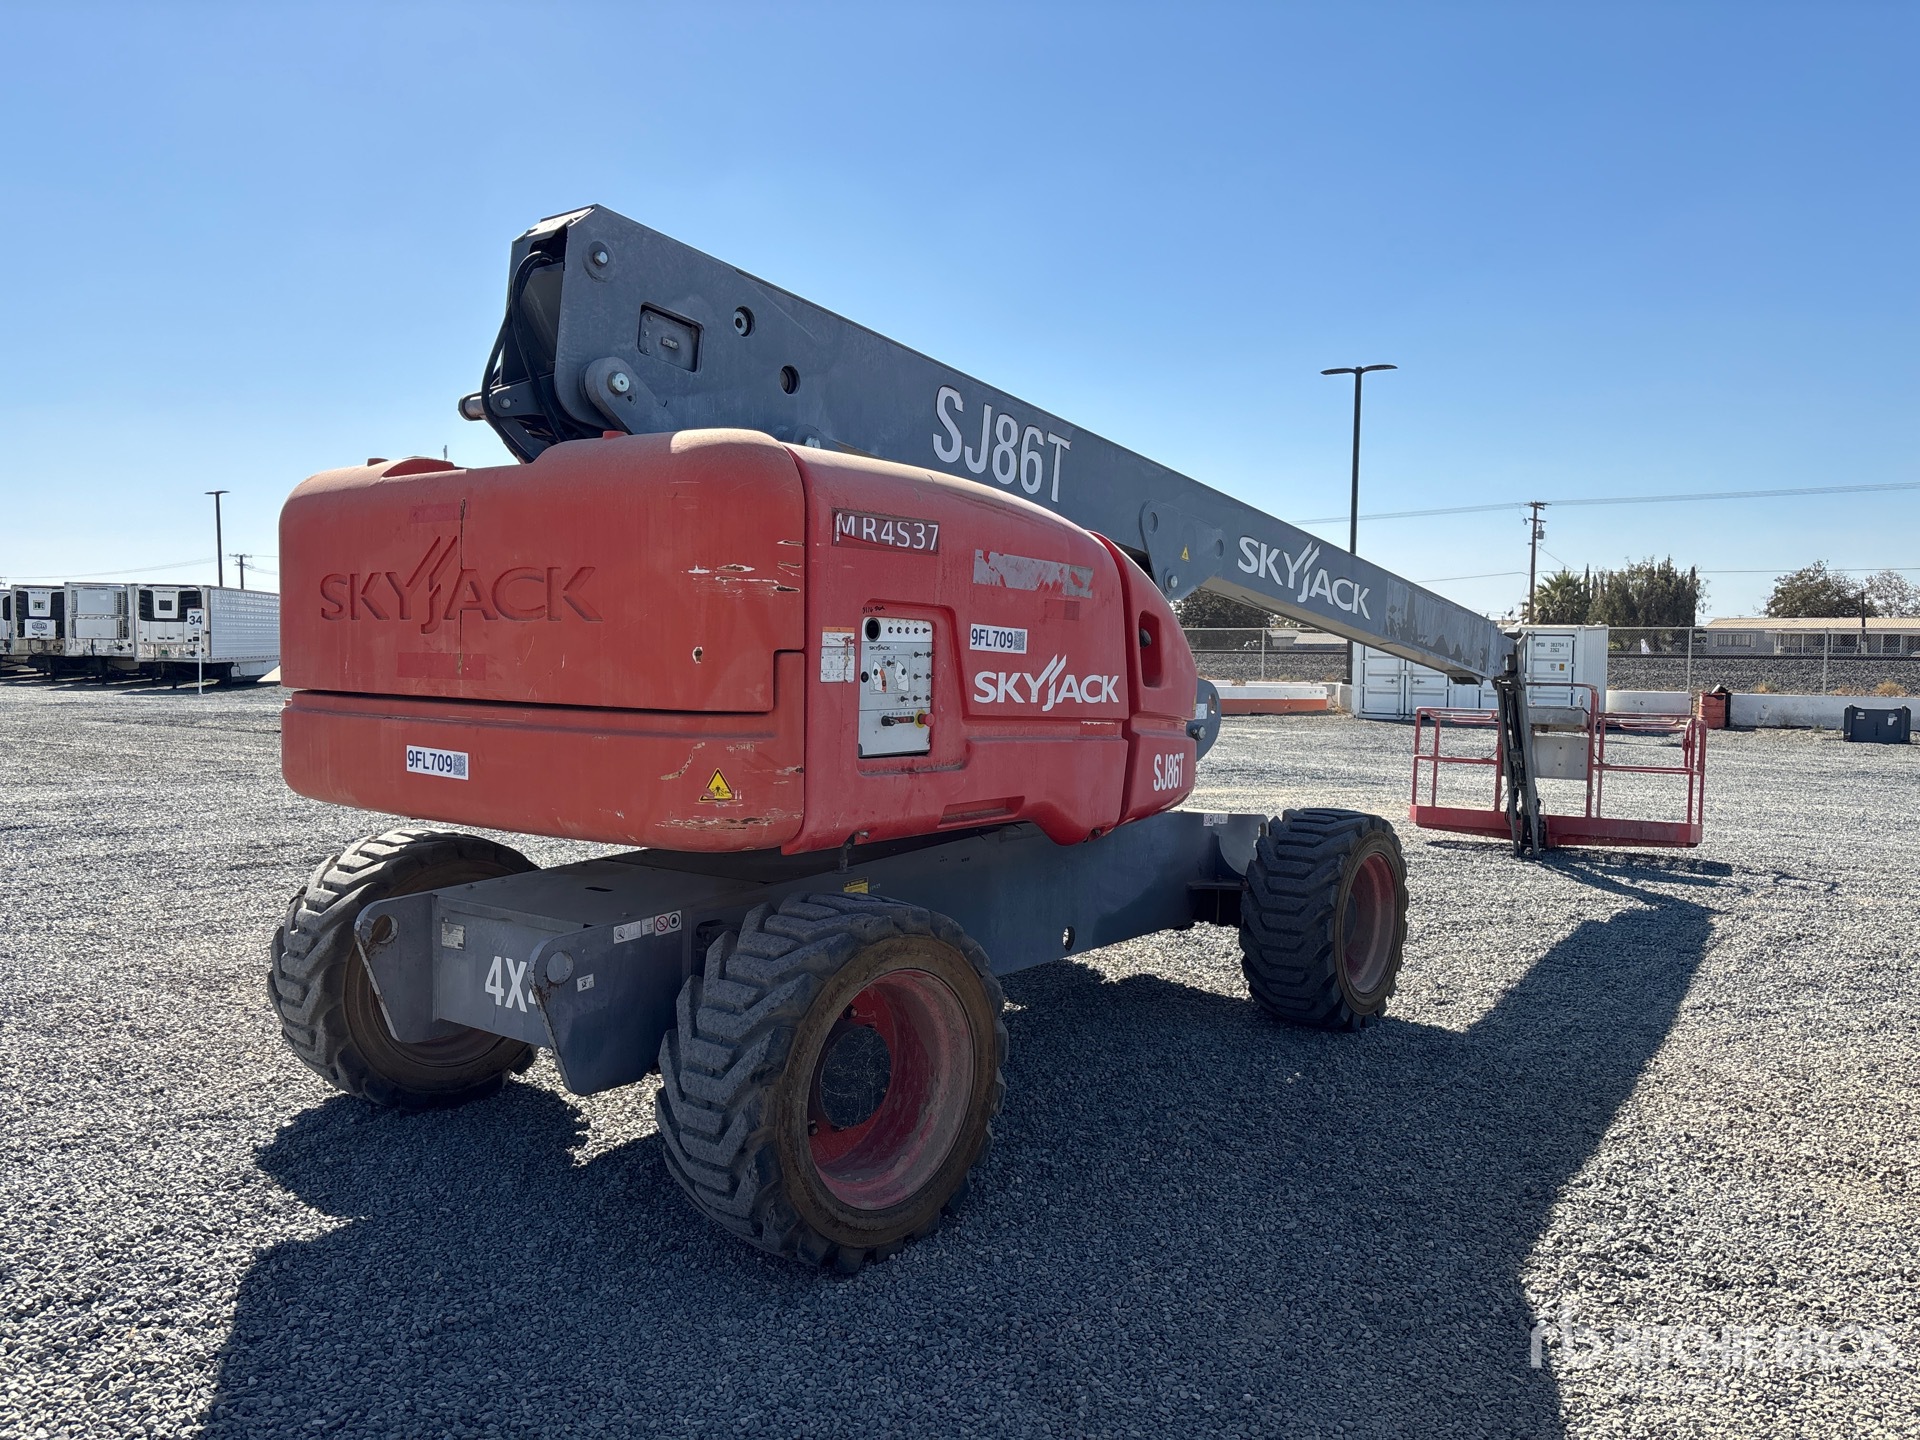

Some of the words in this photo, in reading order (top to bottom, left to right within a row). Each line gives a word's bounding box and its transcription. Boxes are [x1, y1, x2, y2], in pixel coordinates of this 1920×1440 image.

[933, 385, 1071, 502] SJ86T
[320, 536, 603, 634] SKYJACK
[1237, 540, 1371, 620] SKYJACK
[189, 615, 202, 625] 34
[971, 628, 1014, 649] 9FL709
[974, 654, 1119, 711] SKYJACK
[408, 750, 453, 773] 9FL709
[1153, 752, 1185, 791] SJ86T
[485, 955, 536, 1013] 4X
